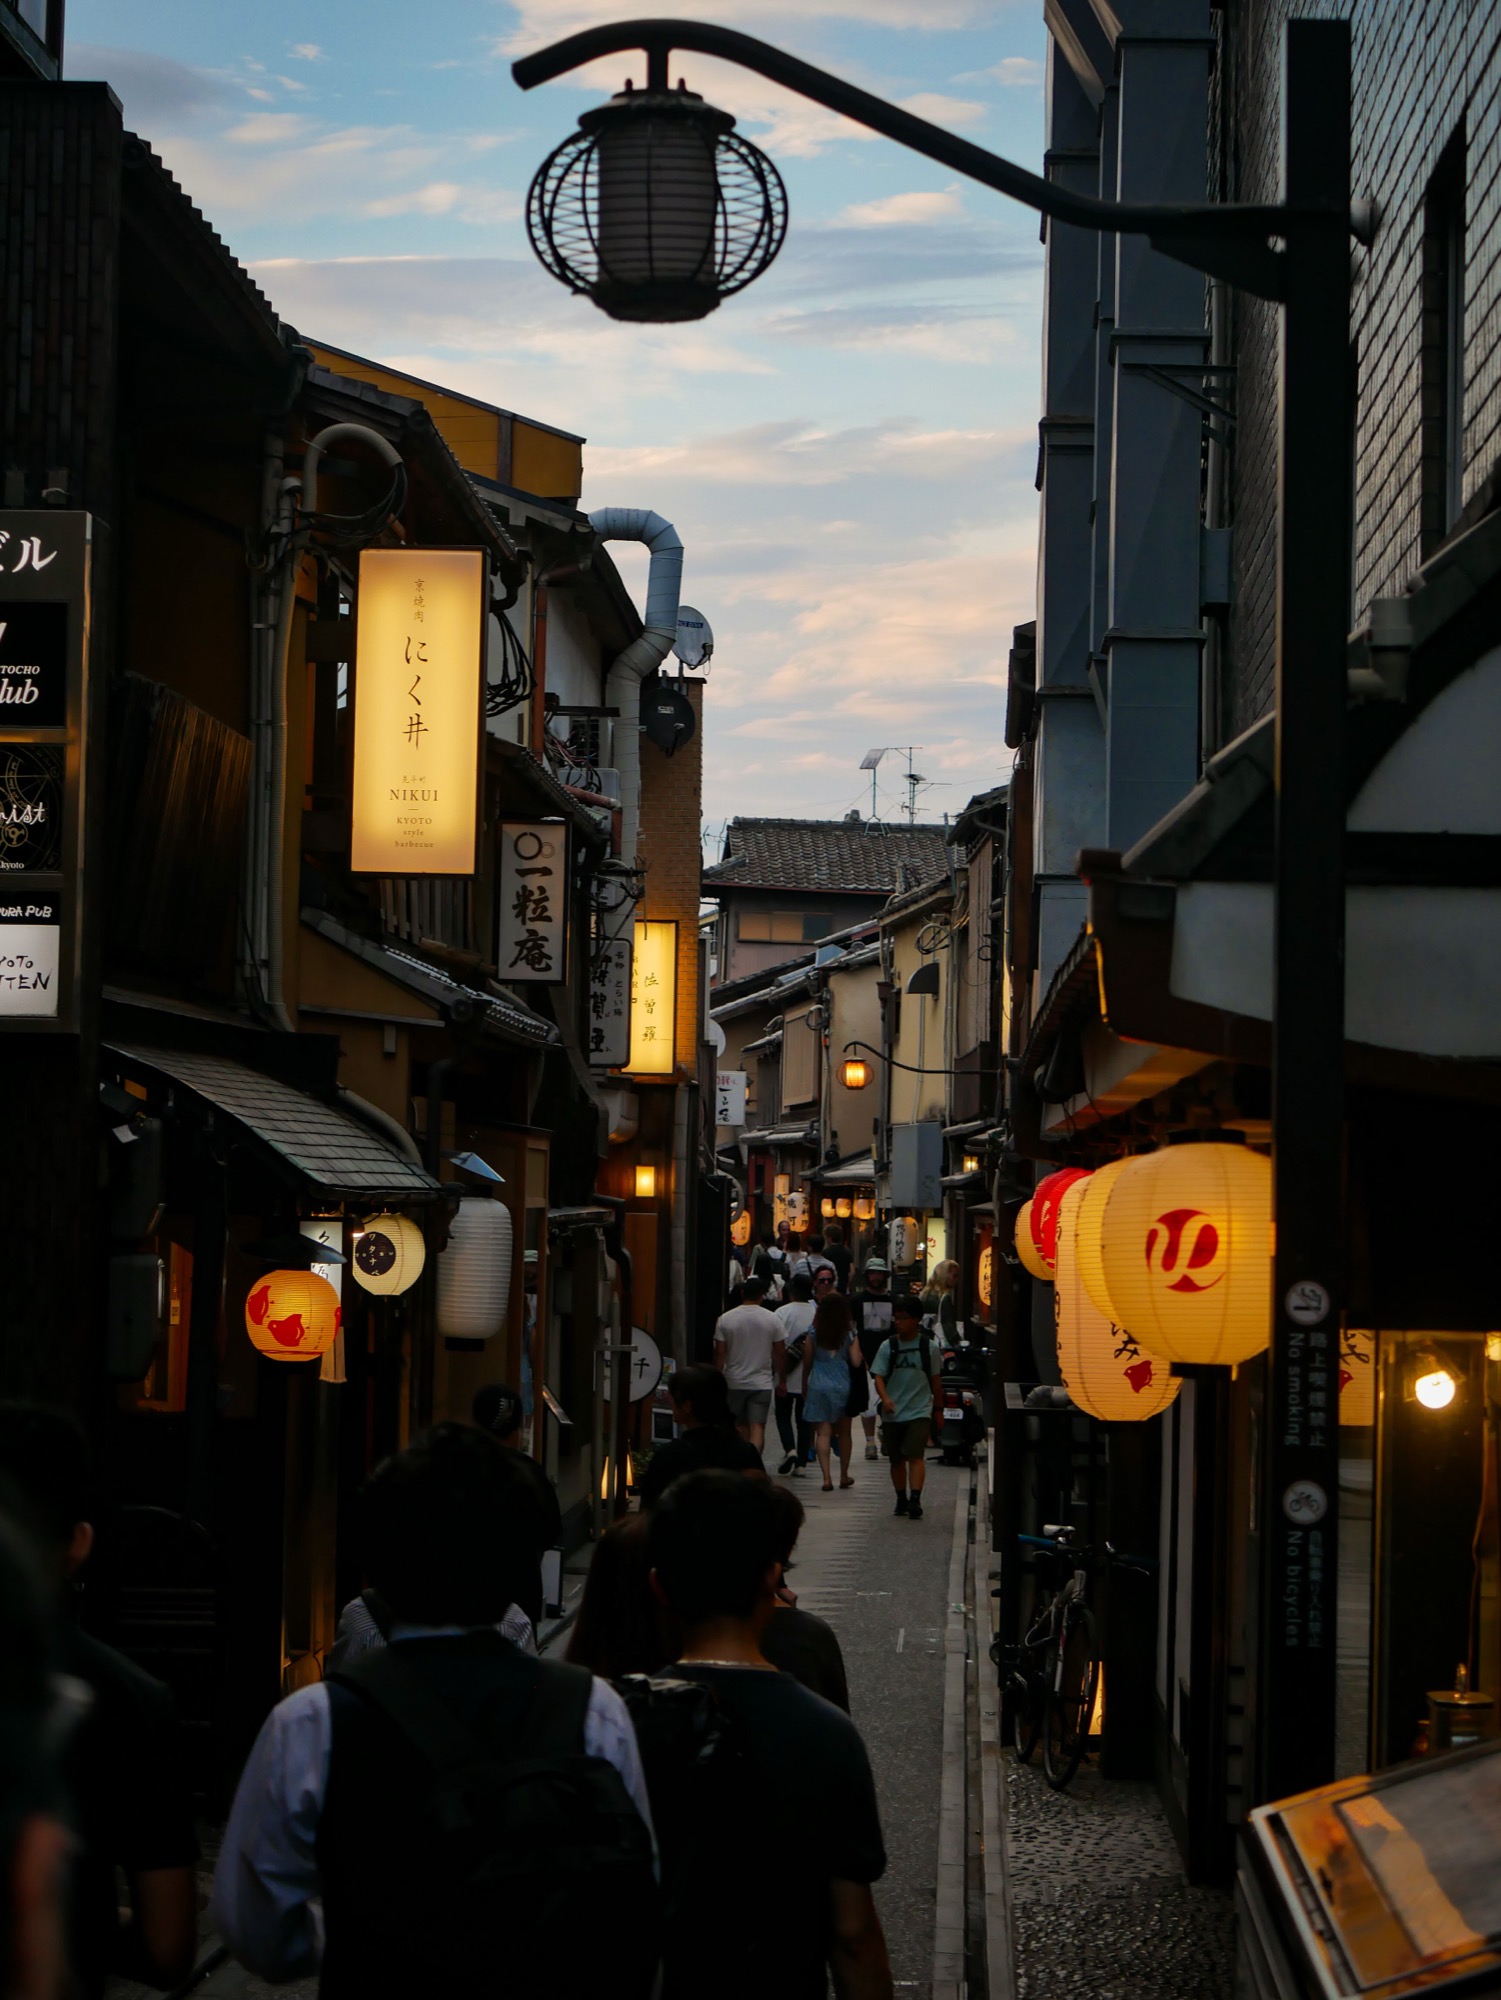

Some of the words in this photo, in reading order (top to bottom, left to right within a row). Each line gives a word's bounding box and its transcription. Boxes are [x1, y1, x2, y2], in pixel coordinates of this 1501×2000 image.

[403, 636, 429, 751] にく井
[390, 789, 438, 801] NIKUI
[396, 817, 432, 825] KYOTO
[403, 829, 424, 838] style
[394, 841, 435, 849] barbecue
[0, 906, 23, 917] URA
[25, 905, 53, 918] PUB
[509, 866, 553, 973] 一粒庵
[1287, 1333, 1305, 1358] No
[1283, 1366, 1304, 1446] smoking
[1287, 1530, 1304, 1556] No
[1282, 1566, 1303, 1647] bicycles
